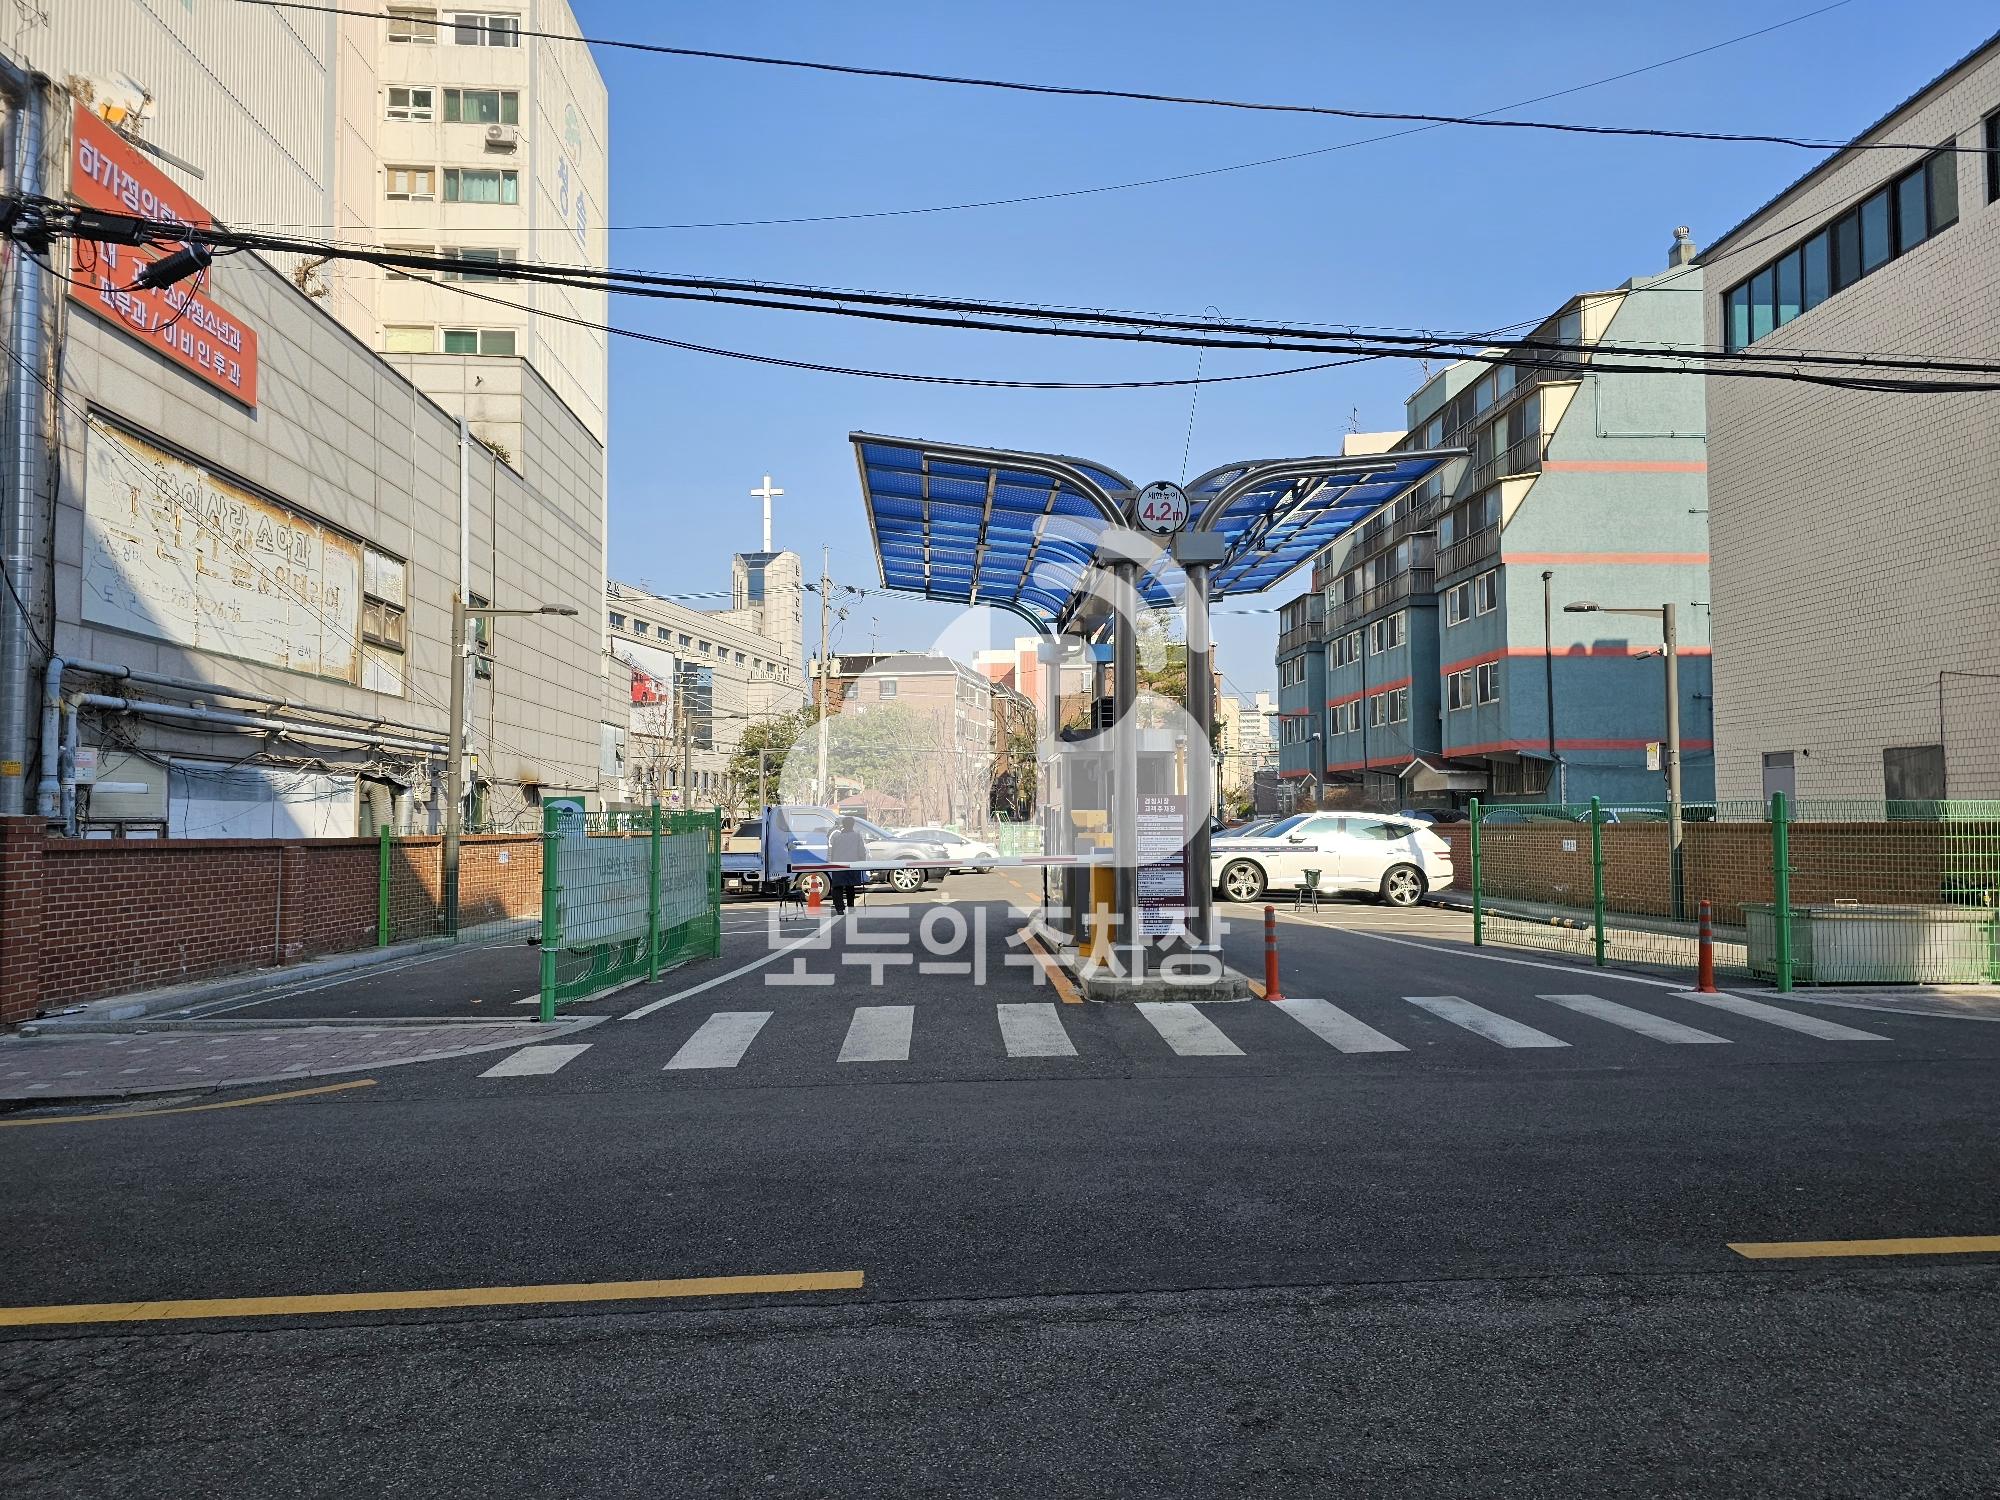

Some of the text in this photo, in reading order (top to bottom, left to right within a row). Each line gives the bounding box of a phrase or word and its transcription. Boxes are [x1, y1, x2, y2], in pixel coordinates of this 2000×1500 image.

[100, 275, 147, 328] 피부과
[164, 318, 241, 387] 이비인후과
[163, 285, 241, 353] 소아청소년과
